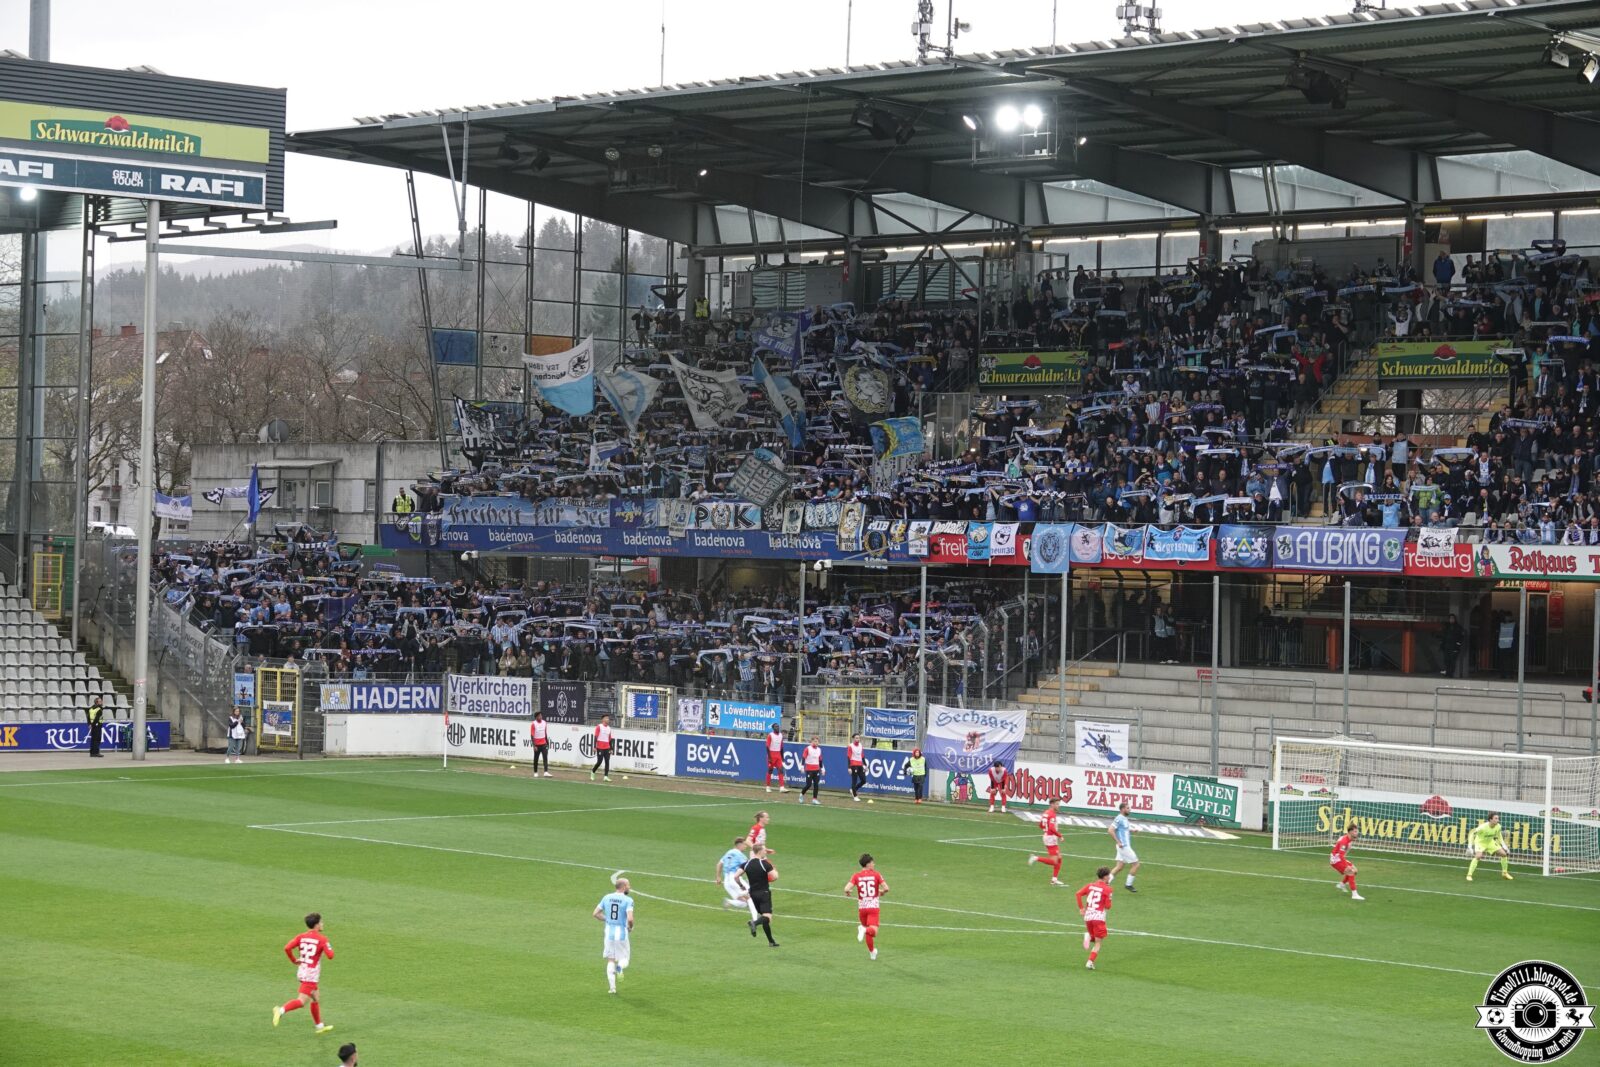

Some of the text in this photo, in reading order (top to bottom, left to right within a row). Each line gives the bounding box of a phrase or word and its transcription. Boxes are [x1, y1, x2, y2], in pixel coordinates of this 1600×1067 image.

[36, 122, 195, 154] Schwarzwaldmilch
[0, 159, 54, 179] AFI
[112, 170, 142, 180] GET IN
[113, 177, 143, 188] TOUCH
[161, 174, 244, 197] RAFI
[488, 528, 534, 542] badenova
[554, 530, 602, 544] badenova
[623, 531, 673, 546] badenova
[694, 533, 745, 547] badenova
[1295, 532, 1380, 565] AUBING
[1508, 546, 1577, 575] Rothaus
[450, 676, 527, 697] Vierkirchen
[353, 685, 440, 710] HADERN
[459, 695, 531, 715] Pasenbach
[723, 704, 776, 719] Löwenfanclub
[732, 719, 766, 731] Abenstal
[470, 727, 516, 747] MERKLE
[687, 743, 721, 764] BGV
[783, 751, 804, 770] GV
[1004, 768, 1074, 805] othaus
[1085, 770, 1156, 790] TANNEN
[1176, 778, 1235, 801] TANNEN
[1087, 788, 1153, 811] ZÄPFLE
[1176, 794, 1231, 817] ZÄPFLE
[859, 882, 876, 897] 36
[1087, 890, 1101, 909] 42
[611, 904, 619, 920] 8
[300, 943, 317, 964] 22
